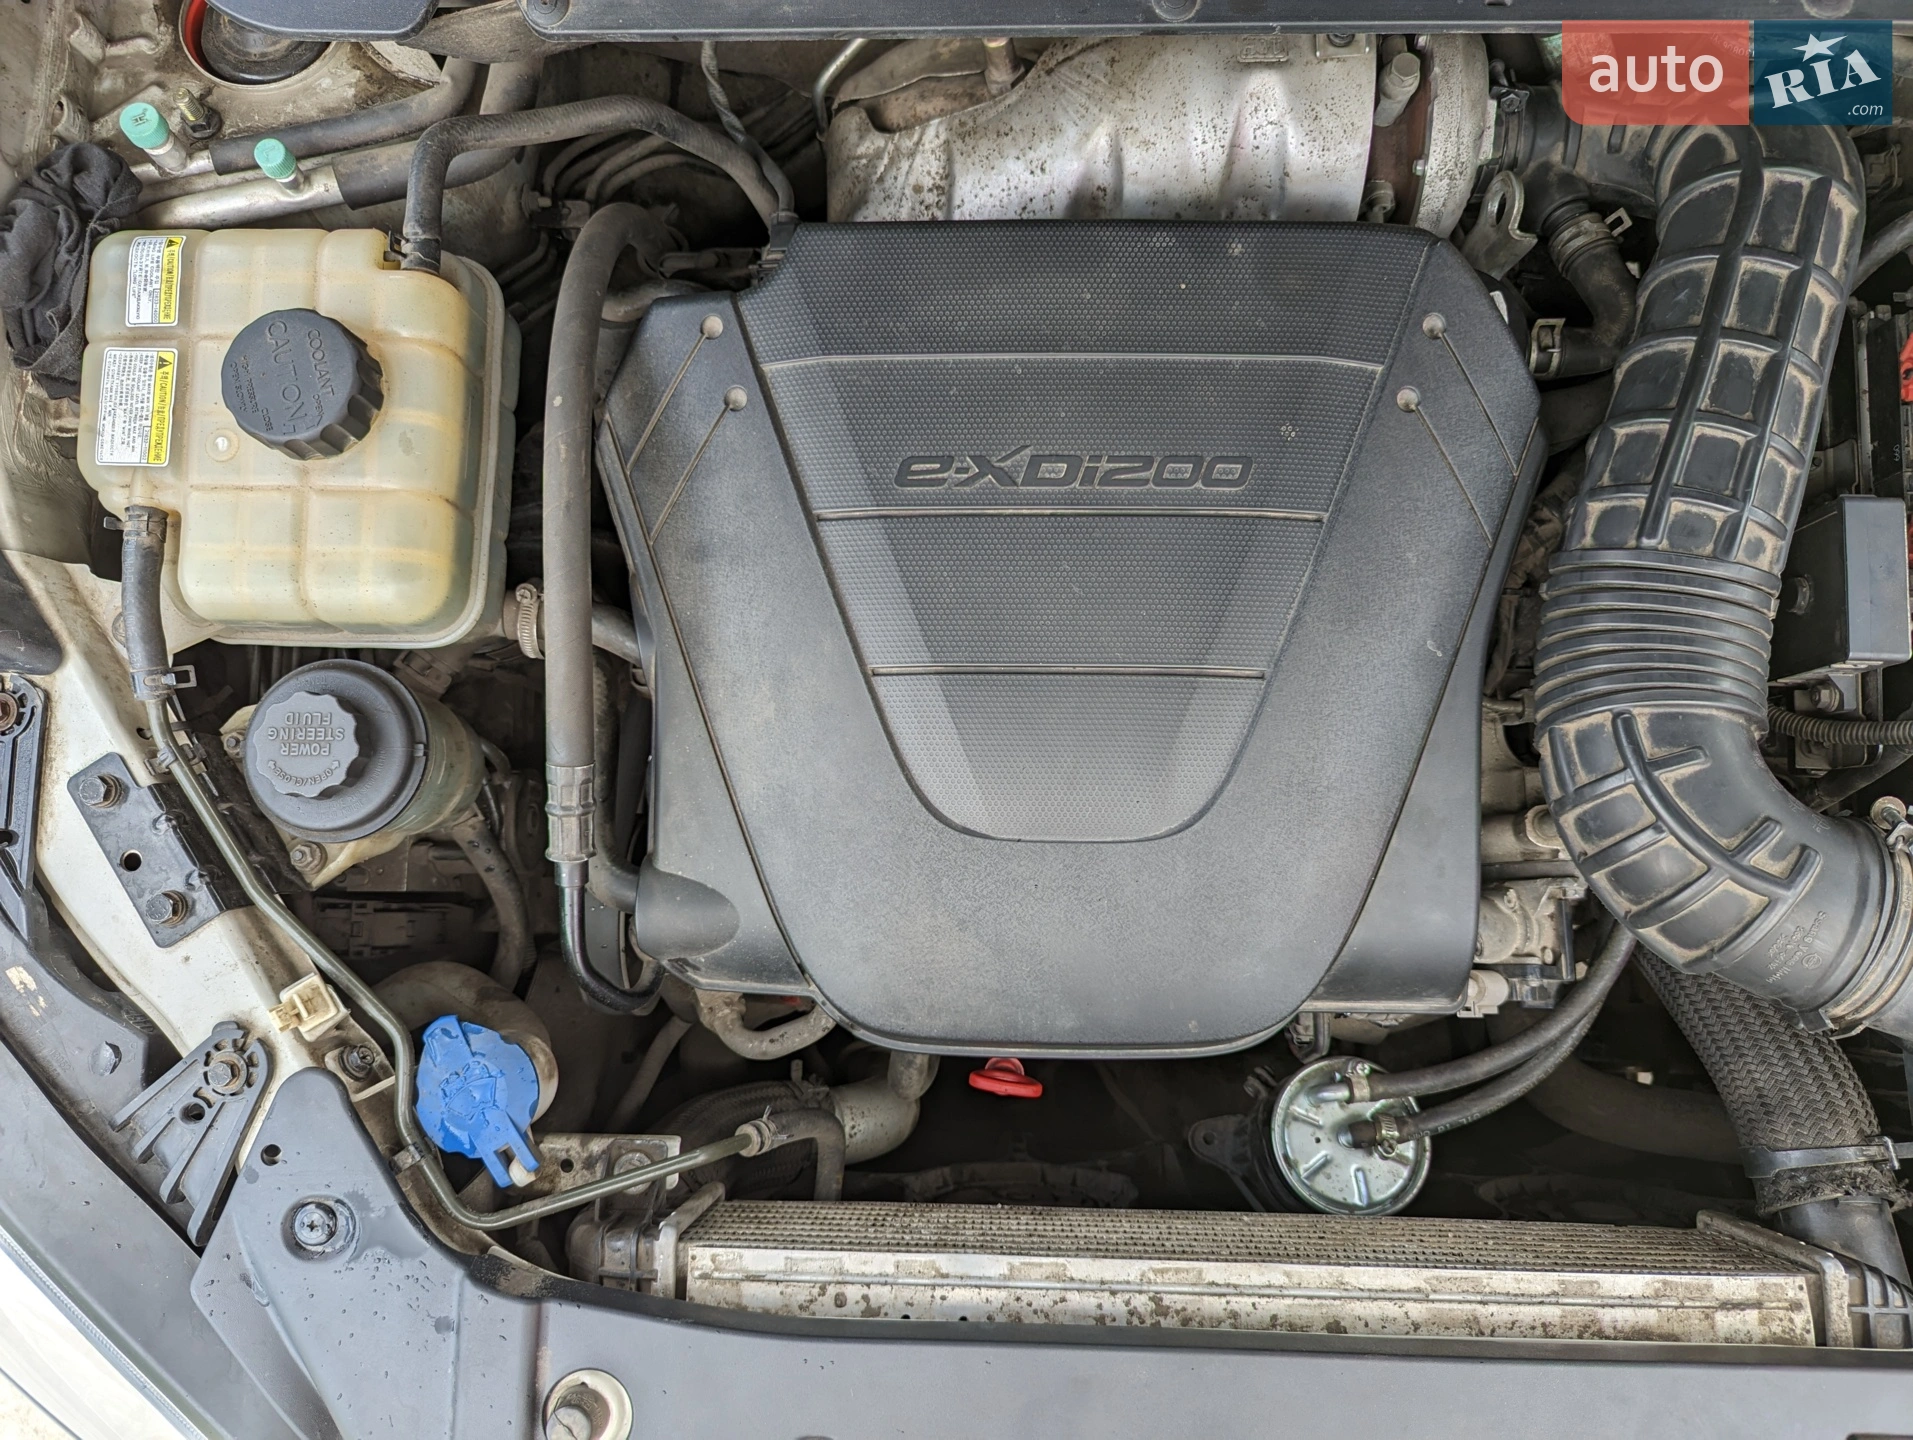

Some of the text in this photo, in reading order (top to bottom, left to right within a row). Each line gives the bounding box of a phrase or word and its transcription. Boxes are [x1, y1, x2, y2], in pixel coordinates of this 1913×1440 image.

[308, 329, 335, 396] COOLANT
[267, 320, 308, 422] CAUTION
[284, 711, 332, 725] FLUID
[267, 727, 345, 741] STEERING
[280, 743, 331, 756] POWER
[273, 768, 333, 787] OPEN/CLOSE
